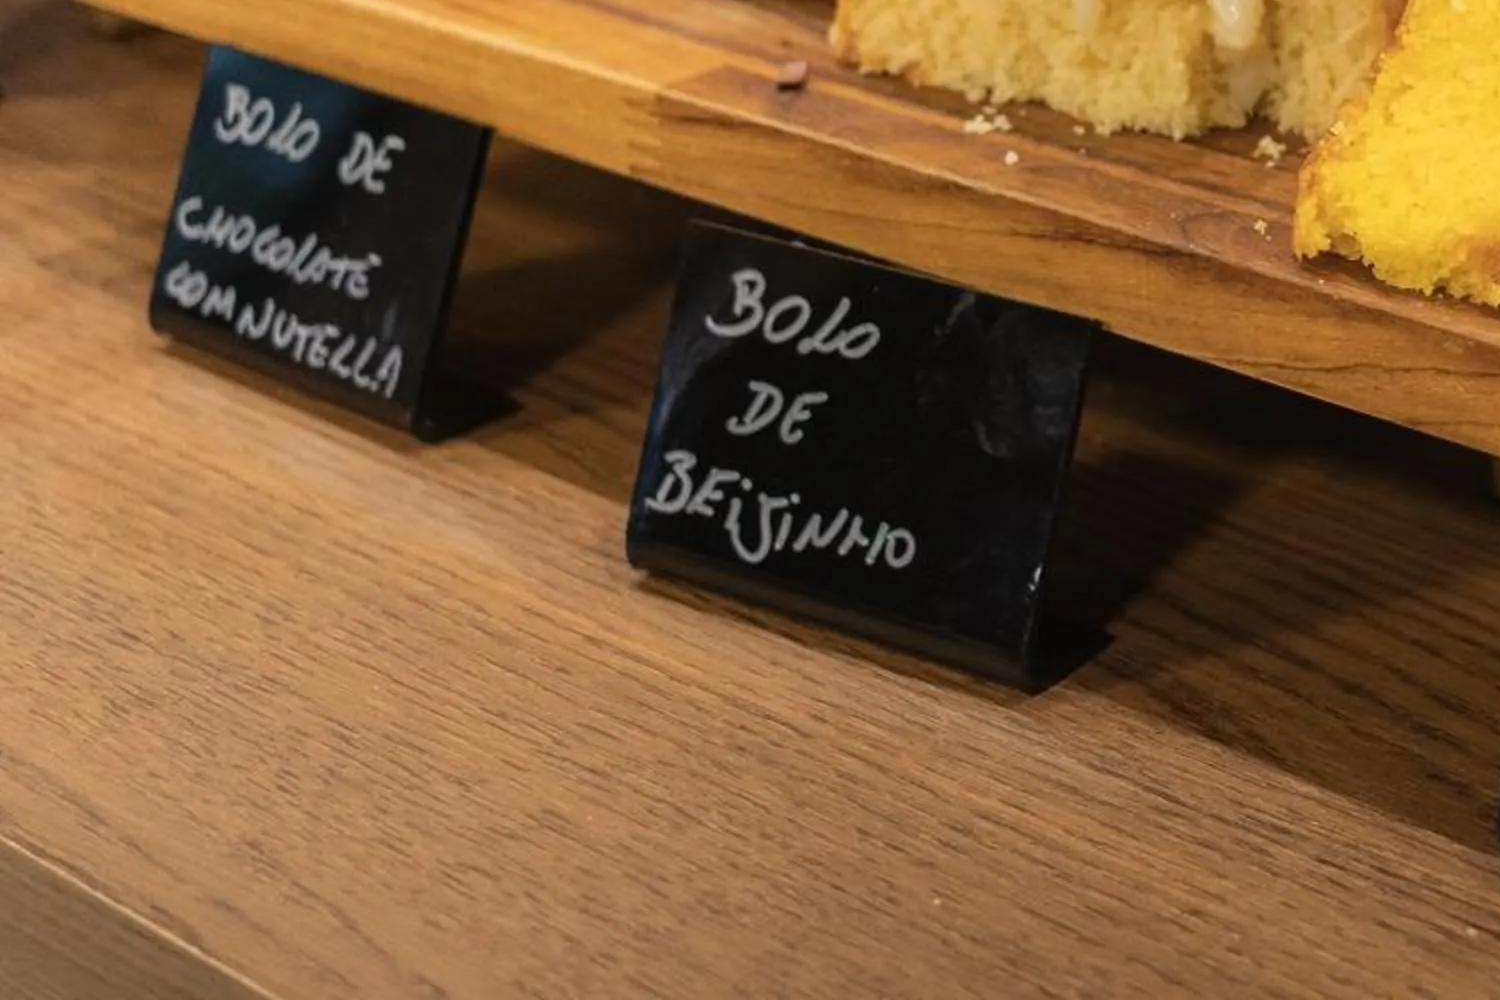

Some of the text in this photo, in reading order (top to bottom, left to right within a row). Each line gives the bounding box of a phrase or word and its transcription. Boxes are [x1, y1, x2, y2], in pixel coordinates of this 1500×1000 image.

[213, 82, 406, 194] BOLO DE
[175, 195, 382, 299] CHOCOLATE
[164, 260, 403, 398] COM NUTELLA
[705, 268, 880, 359] BOLO
[726, 380, 828, 444] DE
